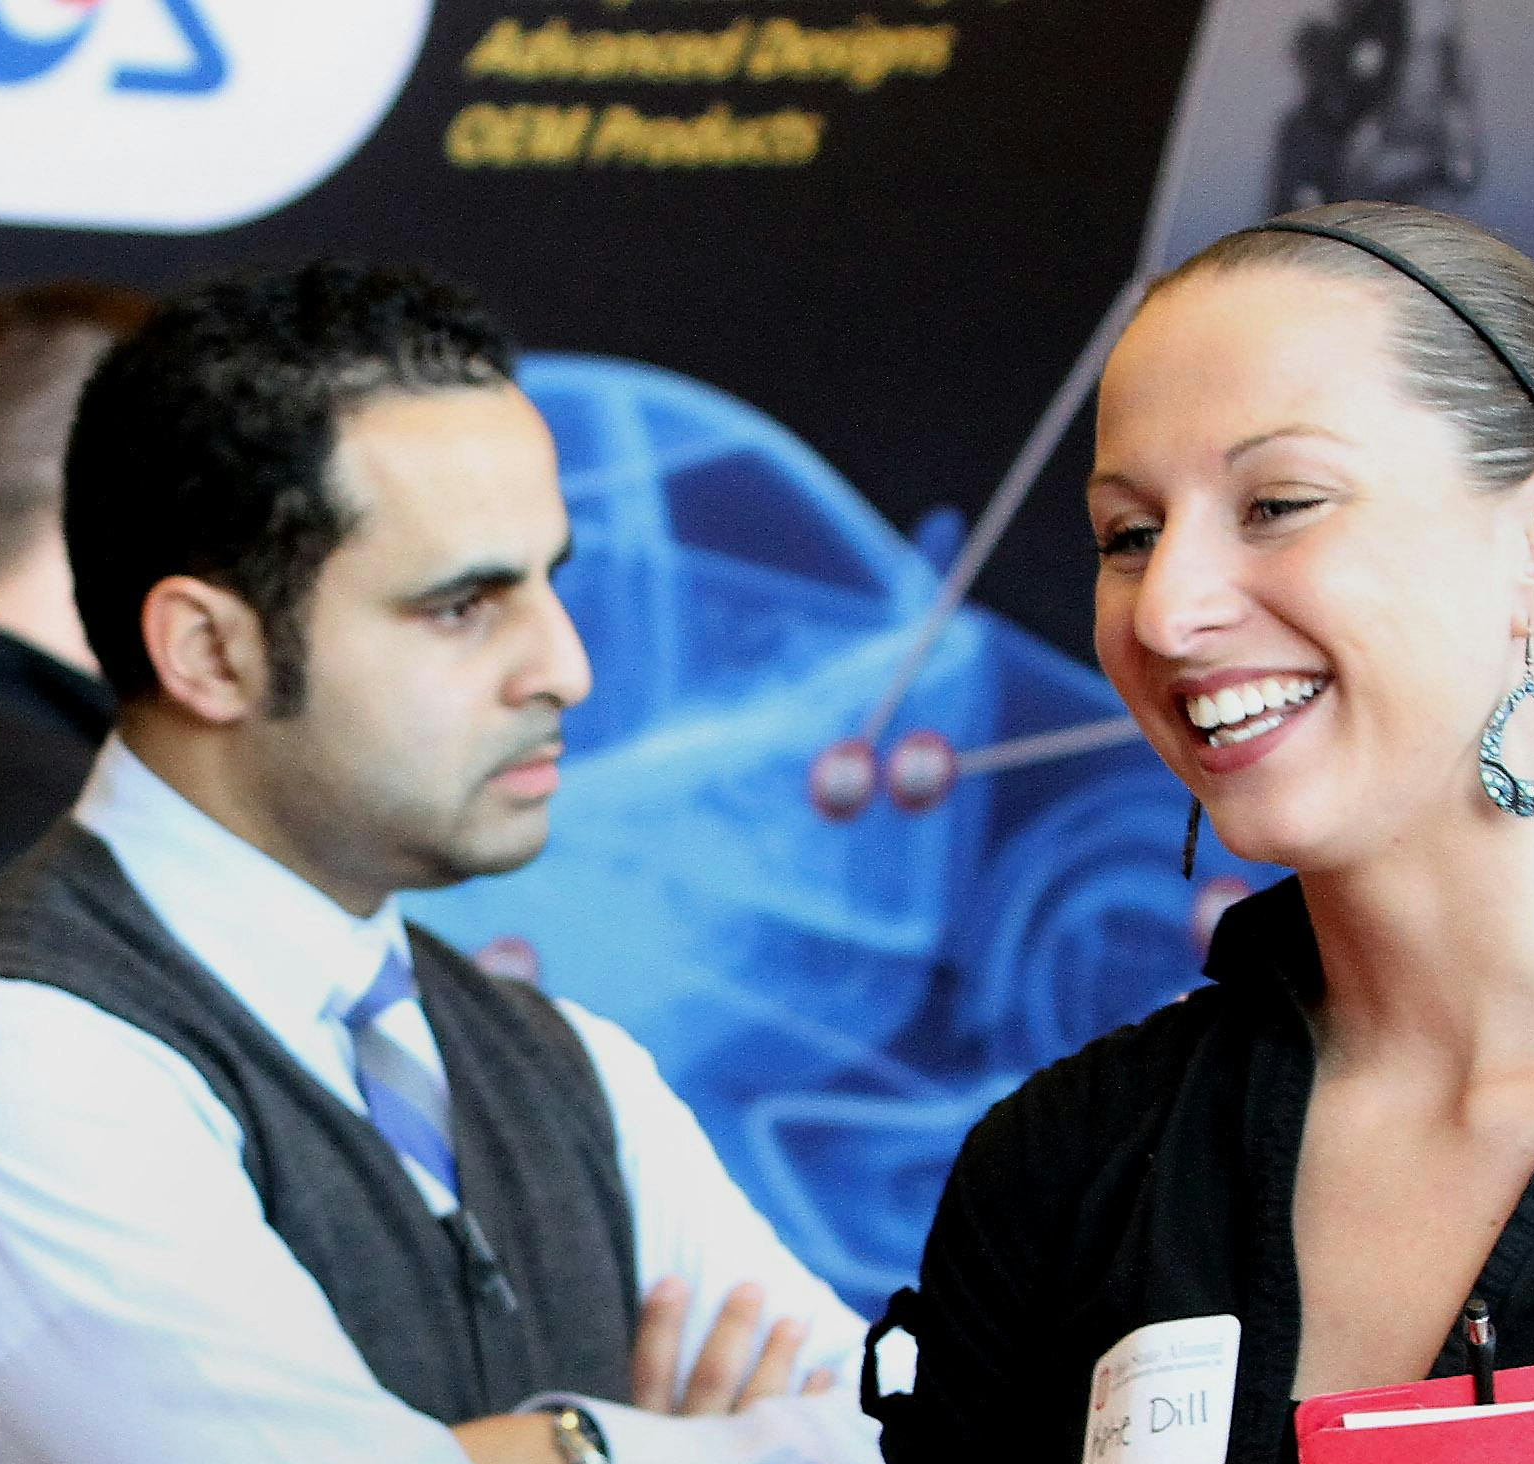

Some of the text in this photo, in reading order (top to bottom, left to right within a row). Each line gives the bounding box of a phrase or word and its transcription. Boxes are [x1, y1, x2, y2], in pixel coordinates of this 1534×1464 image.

[468, 17, 957, 91] Advanced Designs
[445, 103, 824, 167] OEM Products
[1151, 1391, 1207, 1433] Dill
